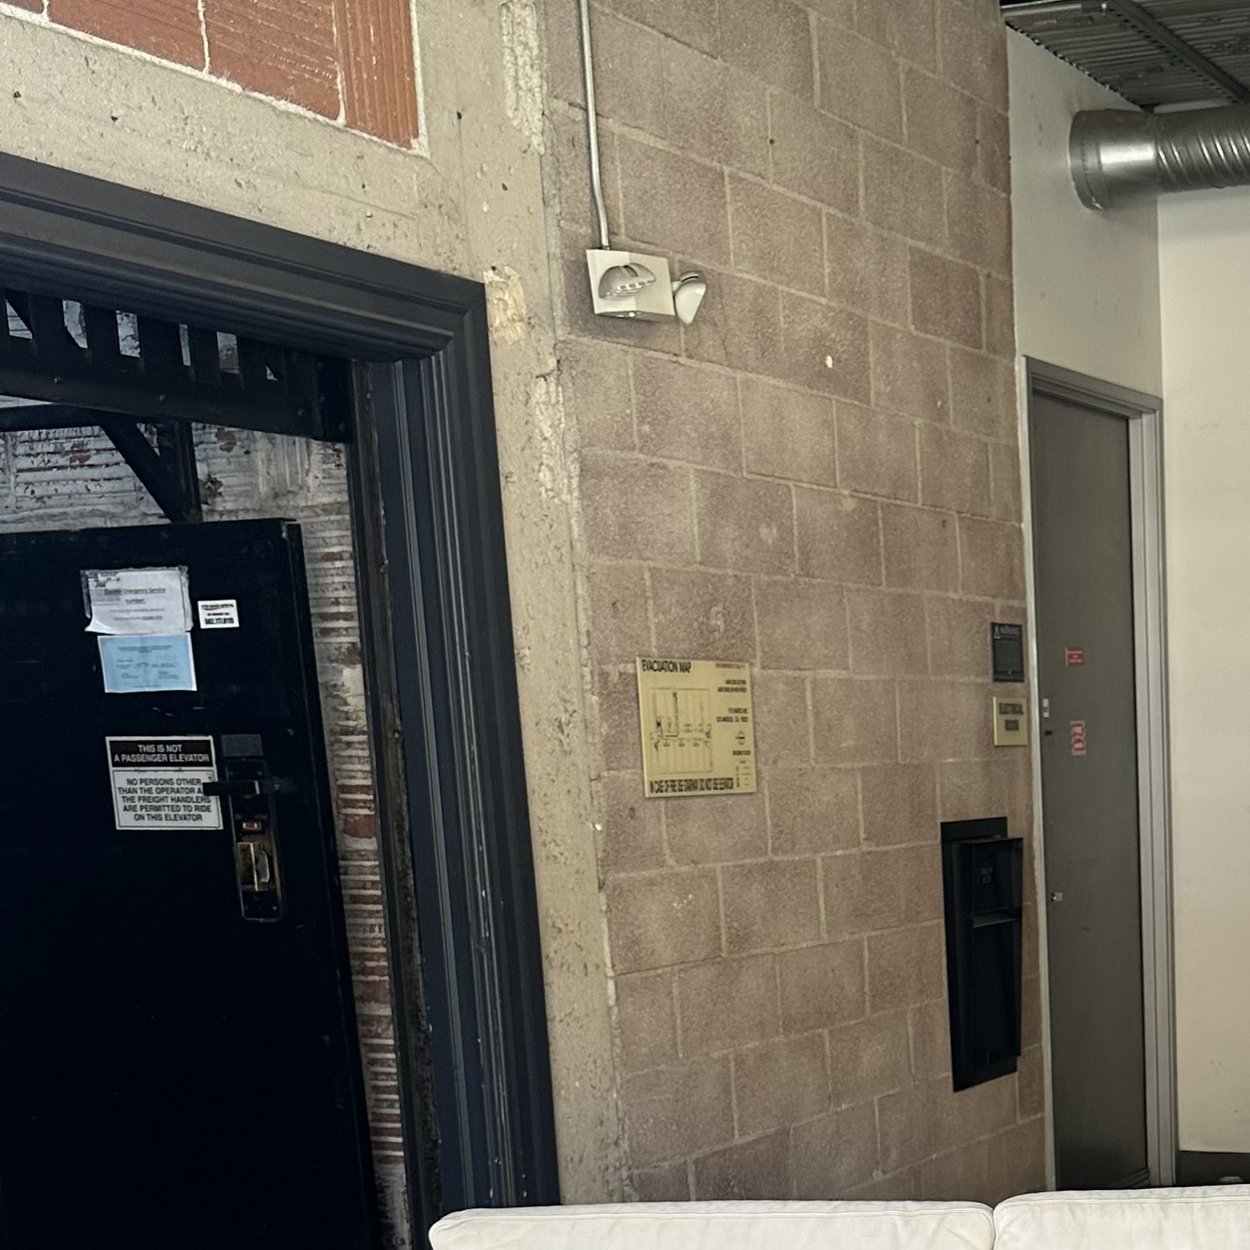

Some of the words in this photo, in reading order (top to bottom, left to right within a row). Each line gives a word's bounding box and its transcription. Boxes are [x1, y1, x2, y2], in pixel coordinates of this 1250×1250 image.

[641, 659, 678, 673] EVACUATION
[137, 744, 155, 753] THIS
[156, 744, 165, 753] IS
[166, 744, 182, 753] NOT
[114, 754, 120, 762] A
[121, 754, 168, 762] PASSENGER
[169, 754, 210, 762] ELEVATOR
[126, 778, 138, 786] NO
[139, 778, 175, 786] PERSONS
[176, 778, 202, 786] OTHER
[117, 787, 138, 795] THAN
[139, 787, 154, 795] THE
[155, 787, 195, 795] OPERATOR
[133, 813, 145, 821] ON
[146, 813, 163, 821] THIS
[164, 813, 203, 821] ELEVATOR
